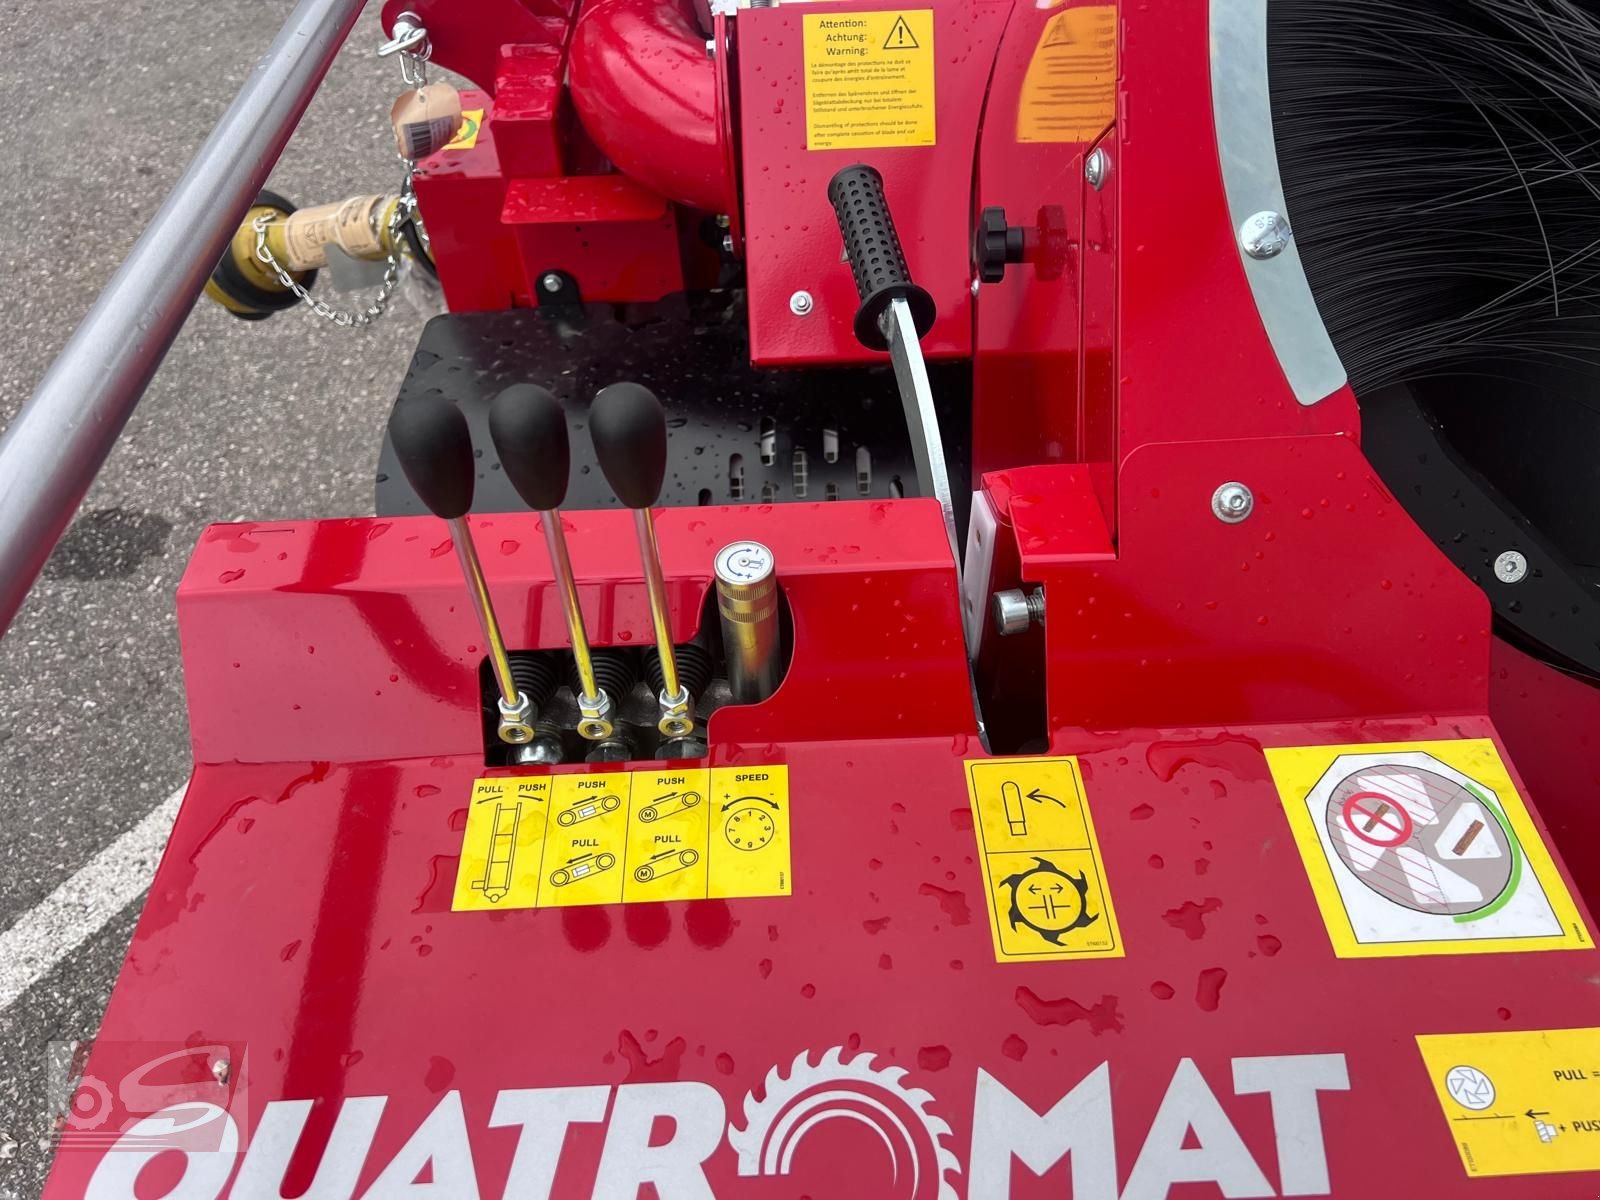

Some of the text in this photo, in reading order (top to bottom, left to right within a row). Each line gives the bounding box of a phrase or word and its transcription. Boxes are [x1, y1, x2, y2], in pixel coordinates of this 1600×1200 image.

[820, 20, 867, 28] Attention:
[826, 33, 867, 42] Achtung:
[826, 46, 868, 56] Warning:
[657, 776, 685, 785] PUSH
[735, 773, 769, 782] SPEED
[518, 784, 546, 792] PUSH
[578, 780, 606, 789] PUSH
[572, 839, 599, 847] PULL
[654, 835, 682, 843] PULL
[1553, 1069, 1588, 1081] PULL
[1572, 1120, 1600, 1132] PUS
